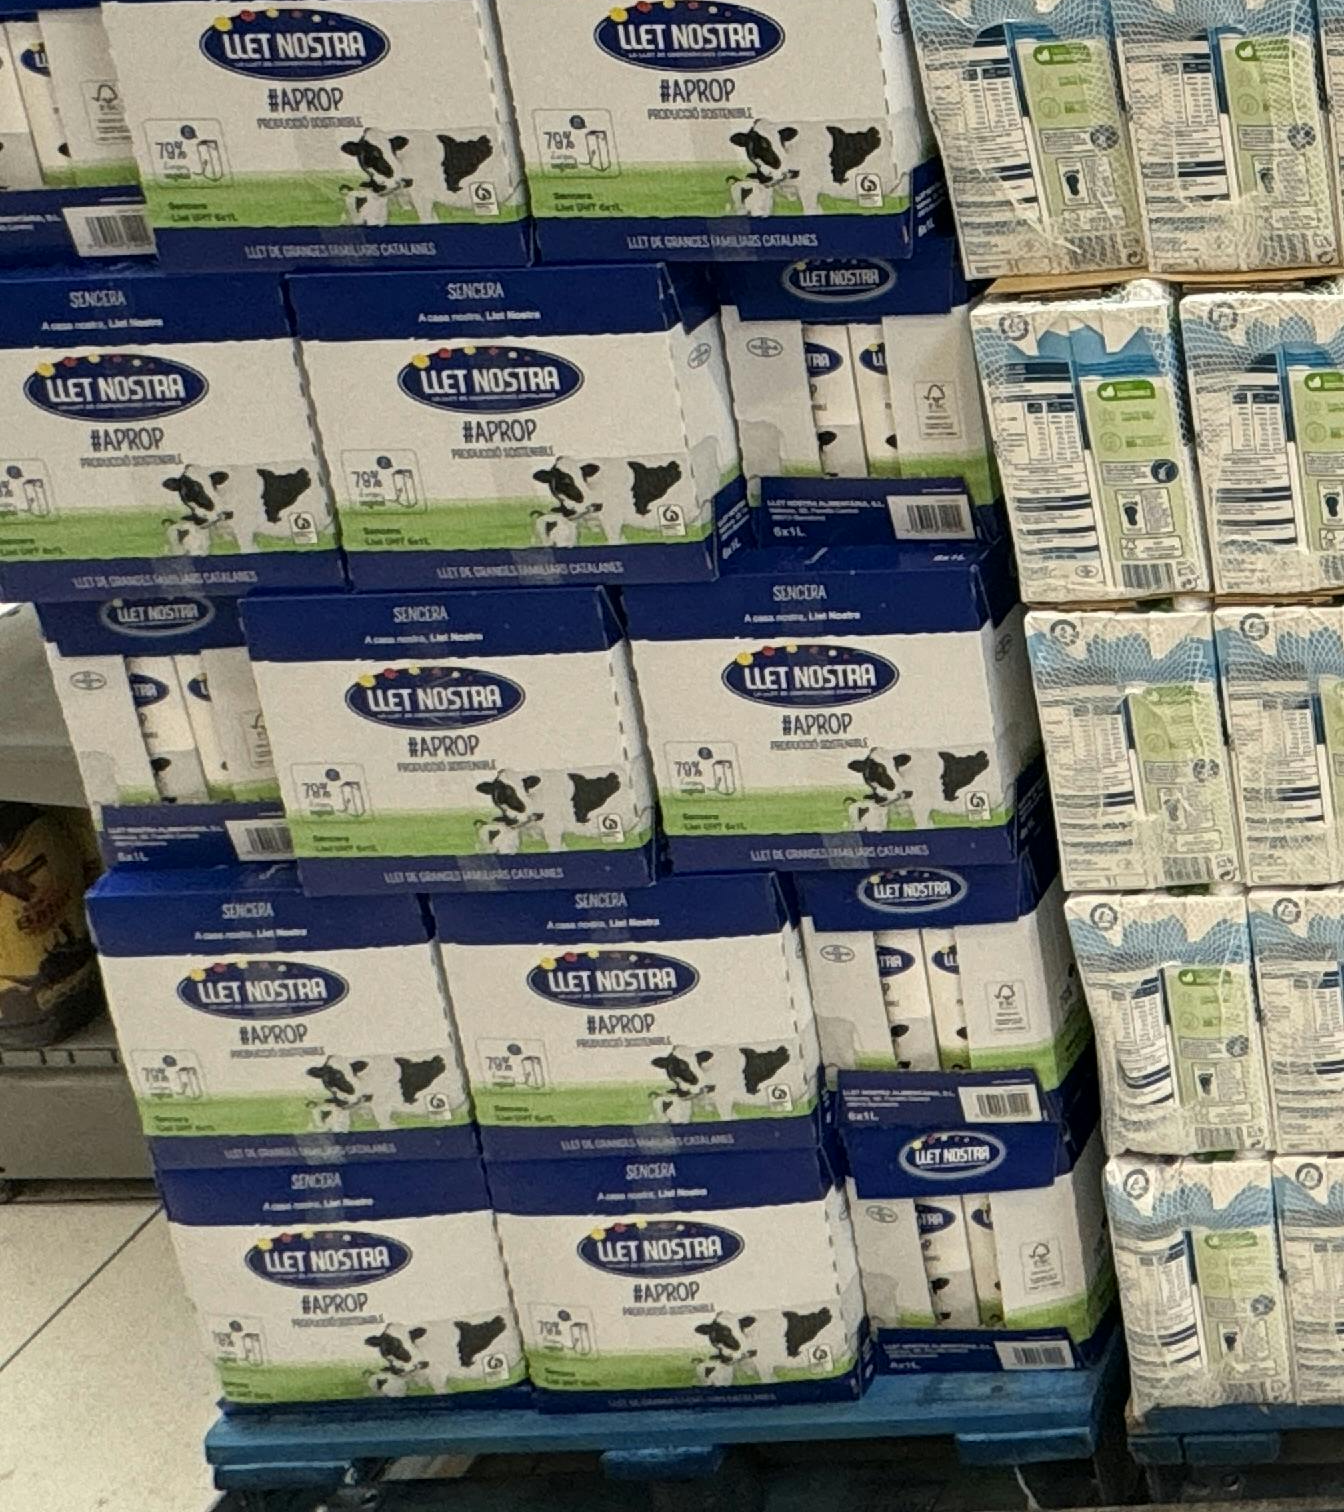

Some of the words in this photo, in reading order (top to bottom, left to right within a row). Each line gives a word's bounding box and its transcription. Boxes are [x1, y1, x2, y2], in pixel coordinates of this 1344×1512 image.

[223, 33, 273, 60] LLET
[277, 31, 366, 60] NOSTRA
[617, 23, 667, 50] LLET
[670, 22, 761, 49] NOSTRA
[267, 88, 344, 113] #APROP
[658, 79, 736, 103] #APROP
[69, 290, 127, 308] SENCERA
[446, 282, 504, 300] SENCERA
[46, 378, 93, 403] LLET
[98, 374, 185, 401] NOSTRA
[419, 369, 470, 395] LLET
[471, 365, 562, 393] NOSTRA
[90, 428, 164, 452] #APROP
[461, 418, 537, 444] #APROP
[772, 585, 828, 601] SENCERA
[116, 604, 147, 622] LLET
[149, 602, 200, 622] NOSTRA
[744, 666, 788, 688] LLET
[793, 663, 876, 687] NOSTRA
[366, 689, 413, 712] LLET
[417, 684, 504, 711] NOSTRA
[873, 882, 901, 900] LLET
[902, 880, 952, 897] NOSTRA
[198, 980, 242, 1003] LLET
[247, 978, 327, 1002] NOSTRA
[546, 970, 592, 992] LLET
[596, 966, 677, 990] NOSTRA
[264, 1249, 306, 1272] LLET
[309, 1246, 390, 1271] NOSTRA
